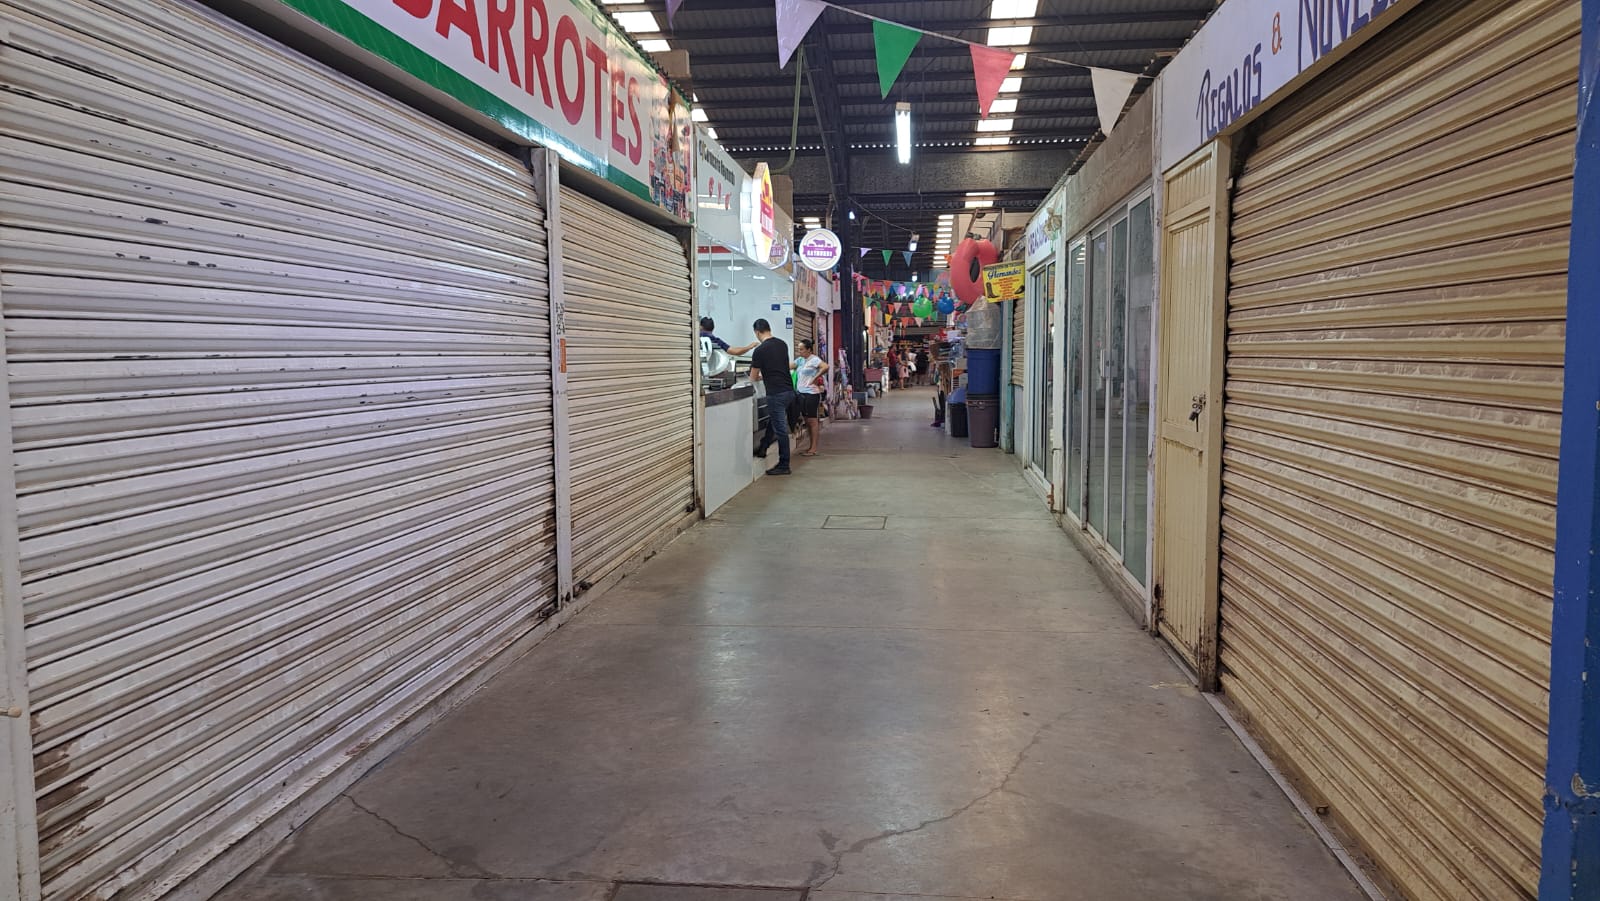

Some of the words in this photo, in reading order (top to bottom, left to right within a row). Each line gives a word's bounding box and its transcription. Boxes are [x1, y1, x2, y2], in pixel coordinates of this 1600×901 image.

[393, 0, 642, 166] ARROTES
[1196, 43, 1261, 144] REGALOS
[1271, 11, 1282, 55] &
